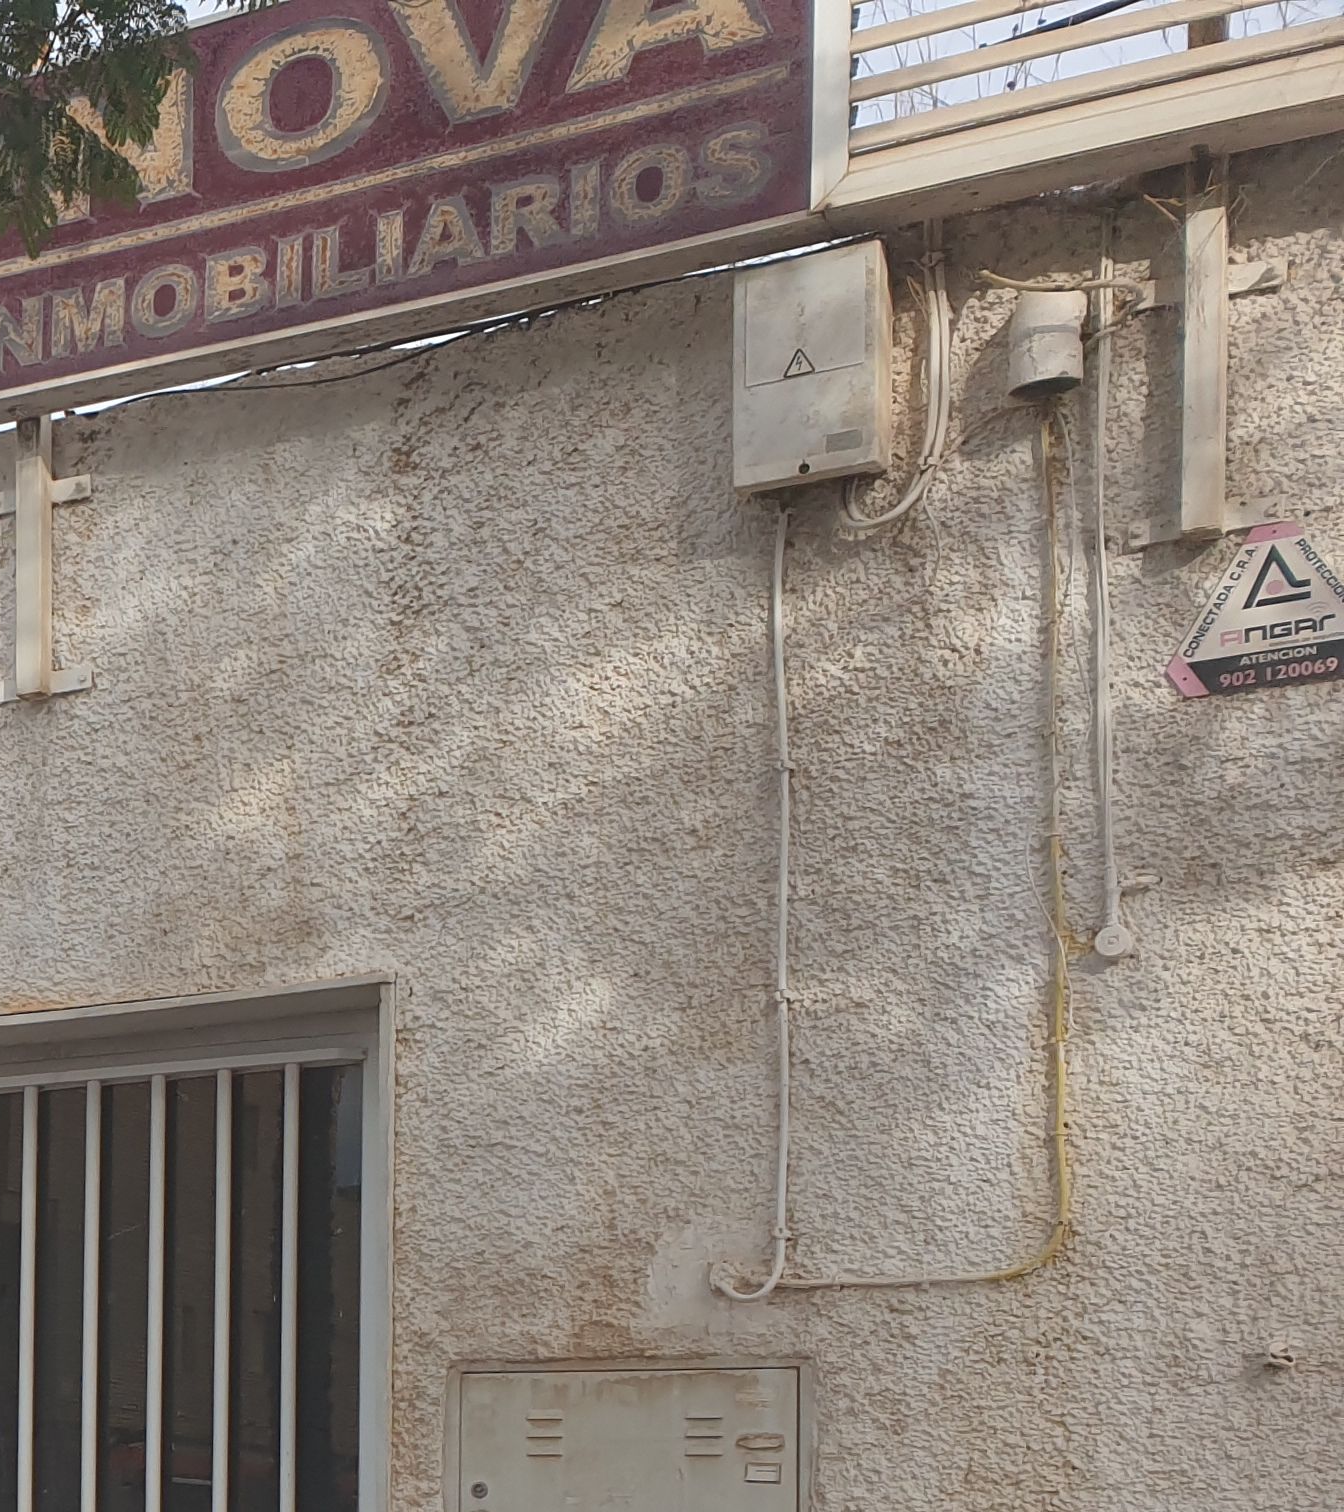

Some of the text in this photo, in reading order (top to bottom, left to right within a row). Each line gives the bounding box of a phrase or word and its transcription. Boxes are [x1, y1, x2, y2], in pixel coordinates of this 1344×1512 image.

[1183, 584, 1235, 658] CONECTADA
[1219, 656, 1339, 689] 902 120069
[1239, 645, 1319, 667] ATENCION
